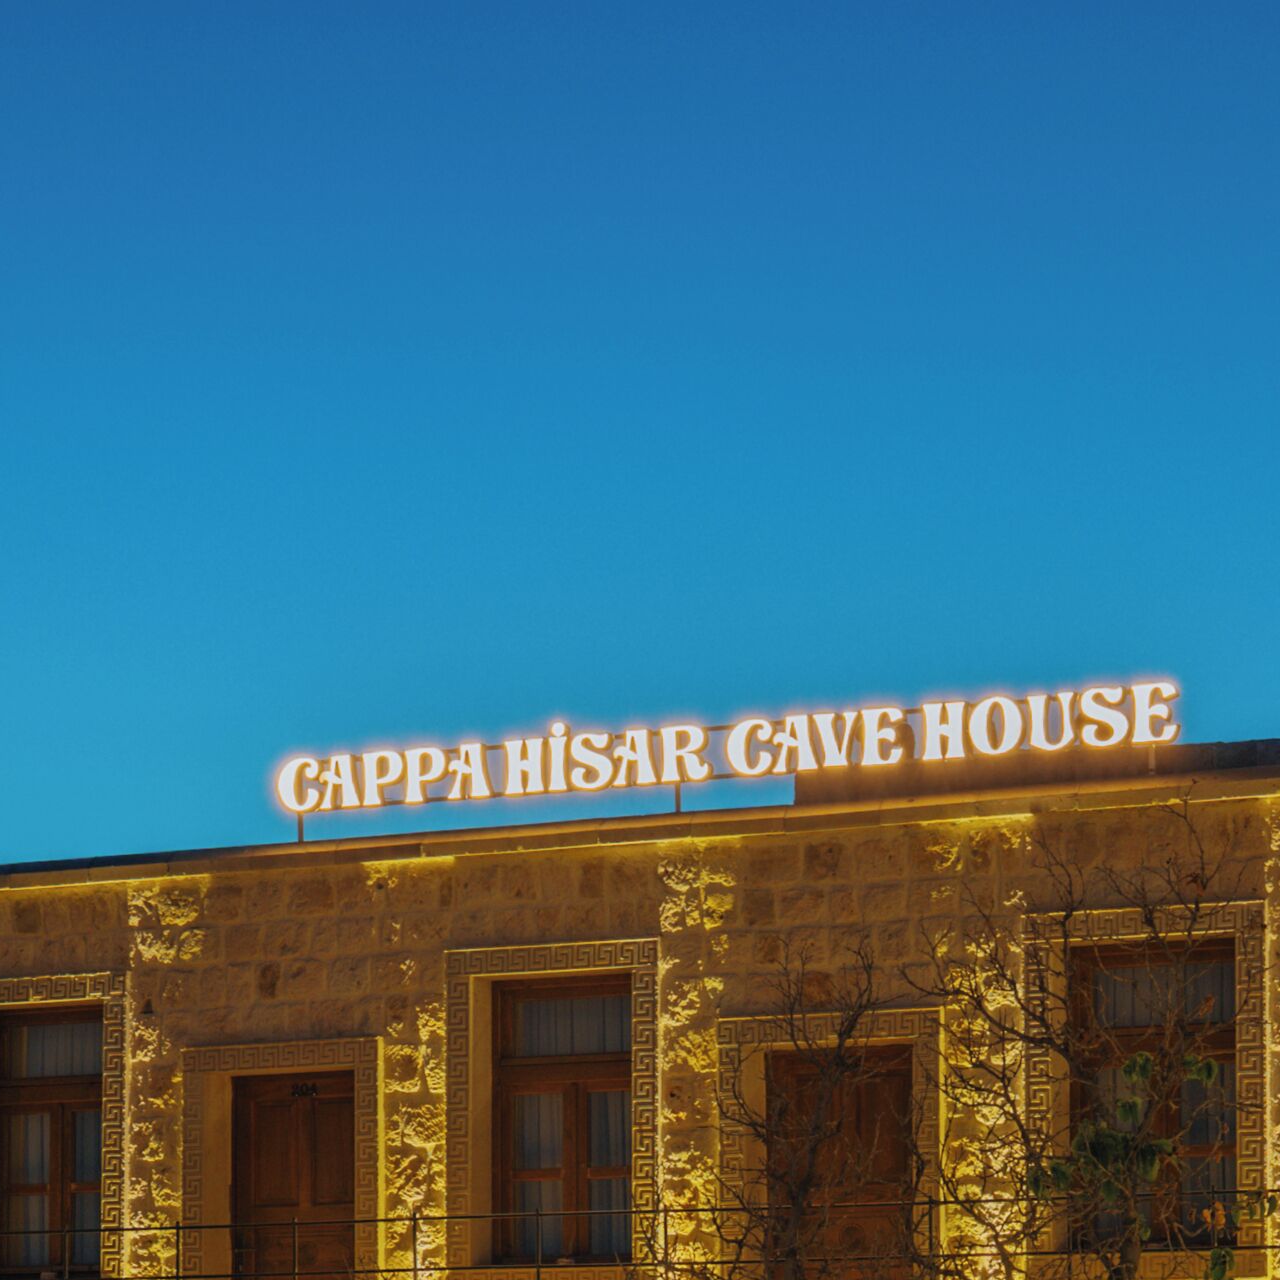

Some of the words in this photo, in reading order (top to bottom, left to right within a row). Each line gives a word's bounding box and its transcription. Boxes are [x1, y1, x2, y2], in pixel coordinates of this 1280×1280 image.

[276, 742, 490, 812] CAPPA
[504, 721, 710, 793] HİSAR
[726, 707, 904, 773] CAVE
[922, 682, 1178, 760] HOUSE
